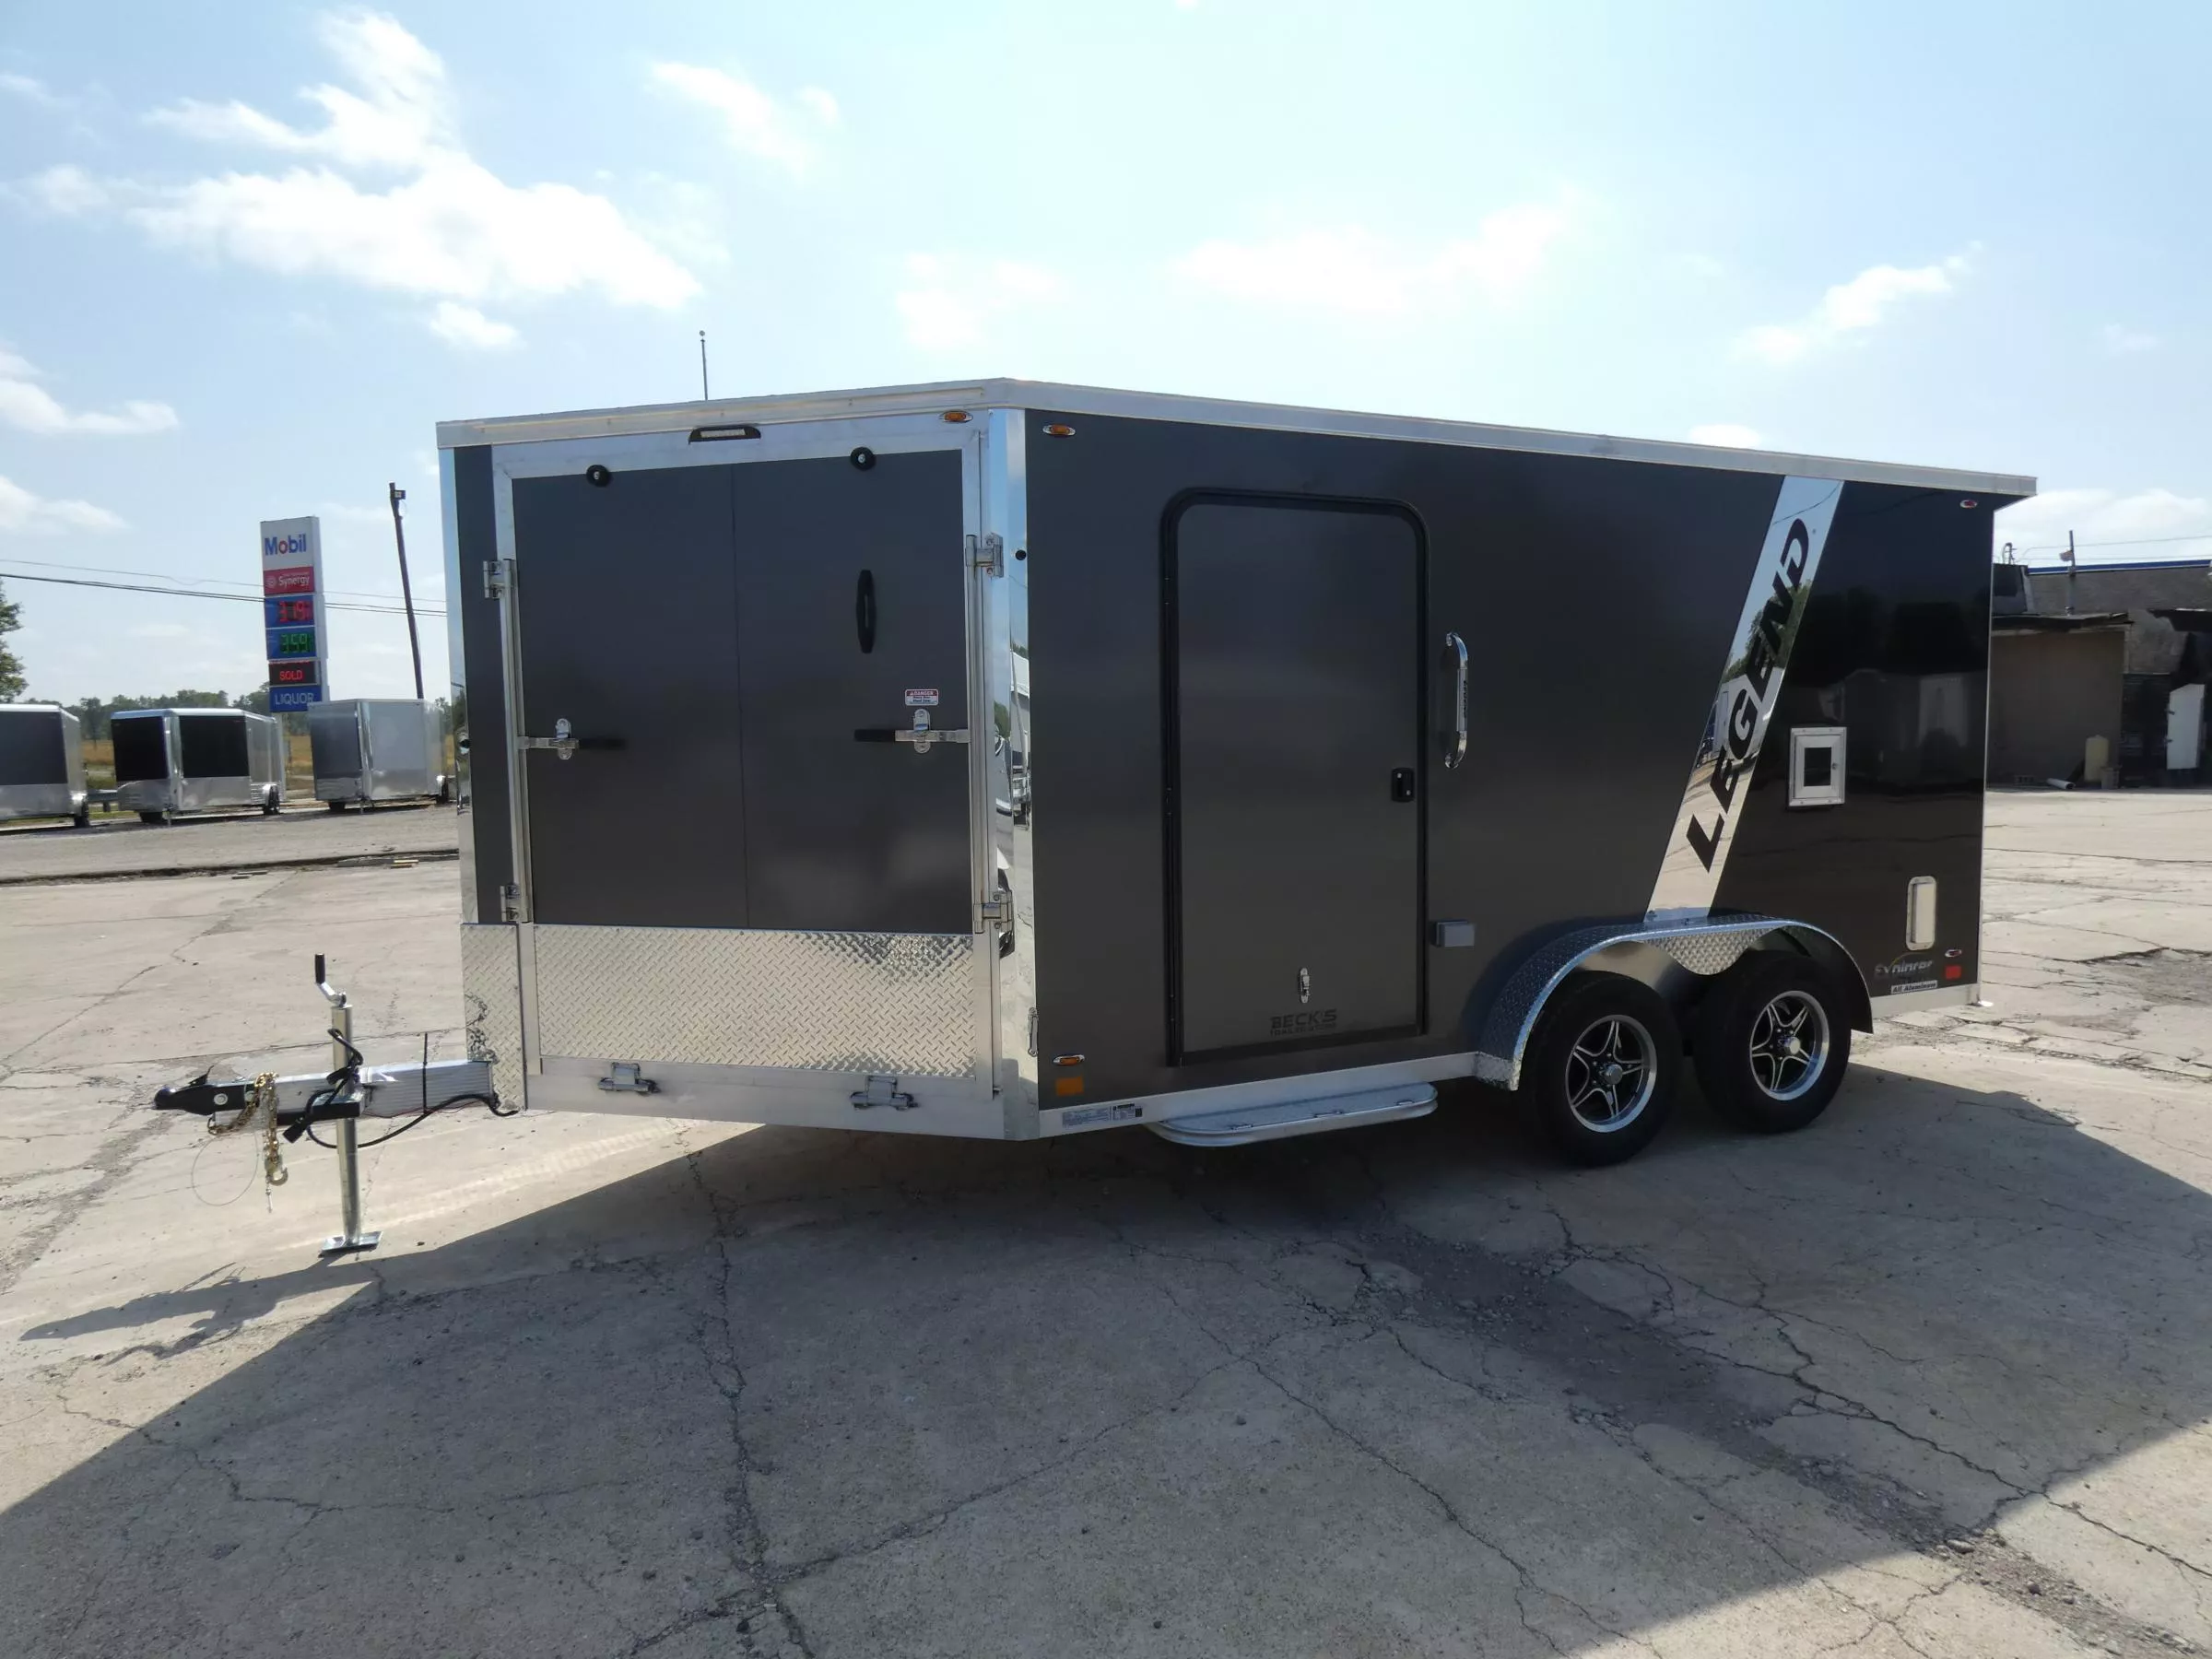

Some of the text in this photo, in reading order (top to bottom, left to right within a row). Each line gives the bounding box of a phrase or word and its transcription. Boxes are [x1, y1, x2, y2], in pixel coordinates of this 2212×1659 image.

[265, 534, 307, 556] Mobil
[278, 575, 310, 590] Synergy
[275, 692, 314, 706] LIQUOR
[1686, 518, 1809, 873] LEGEND
[1270, 1008, 1337, 1029] BECK'S
